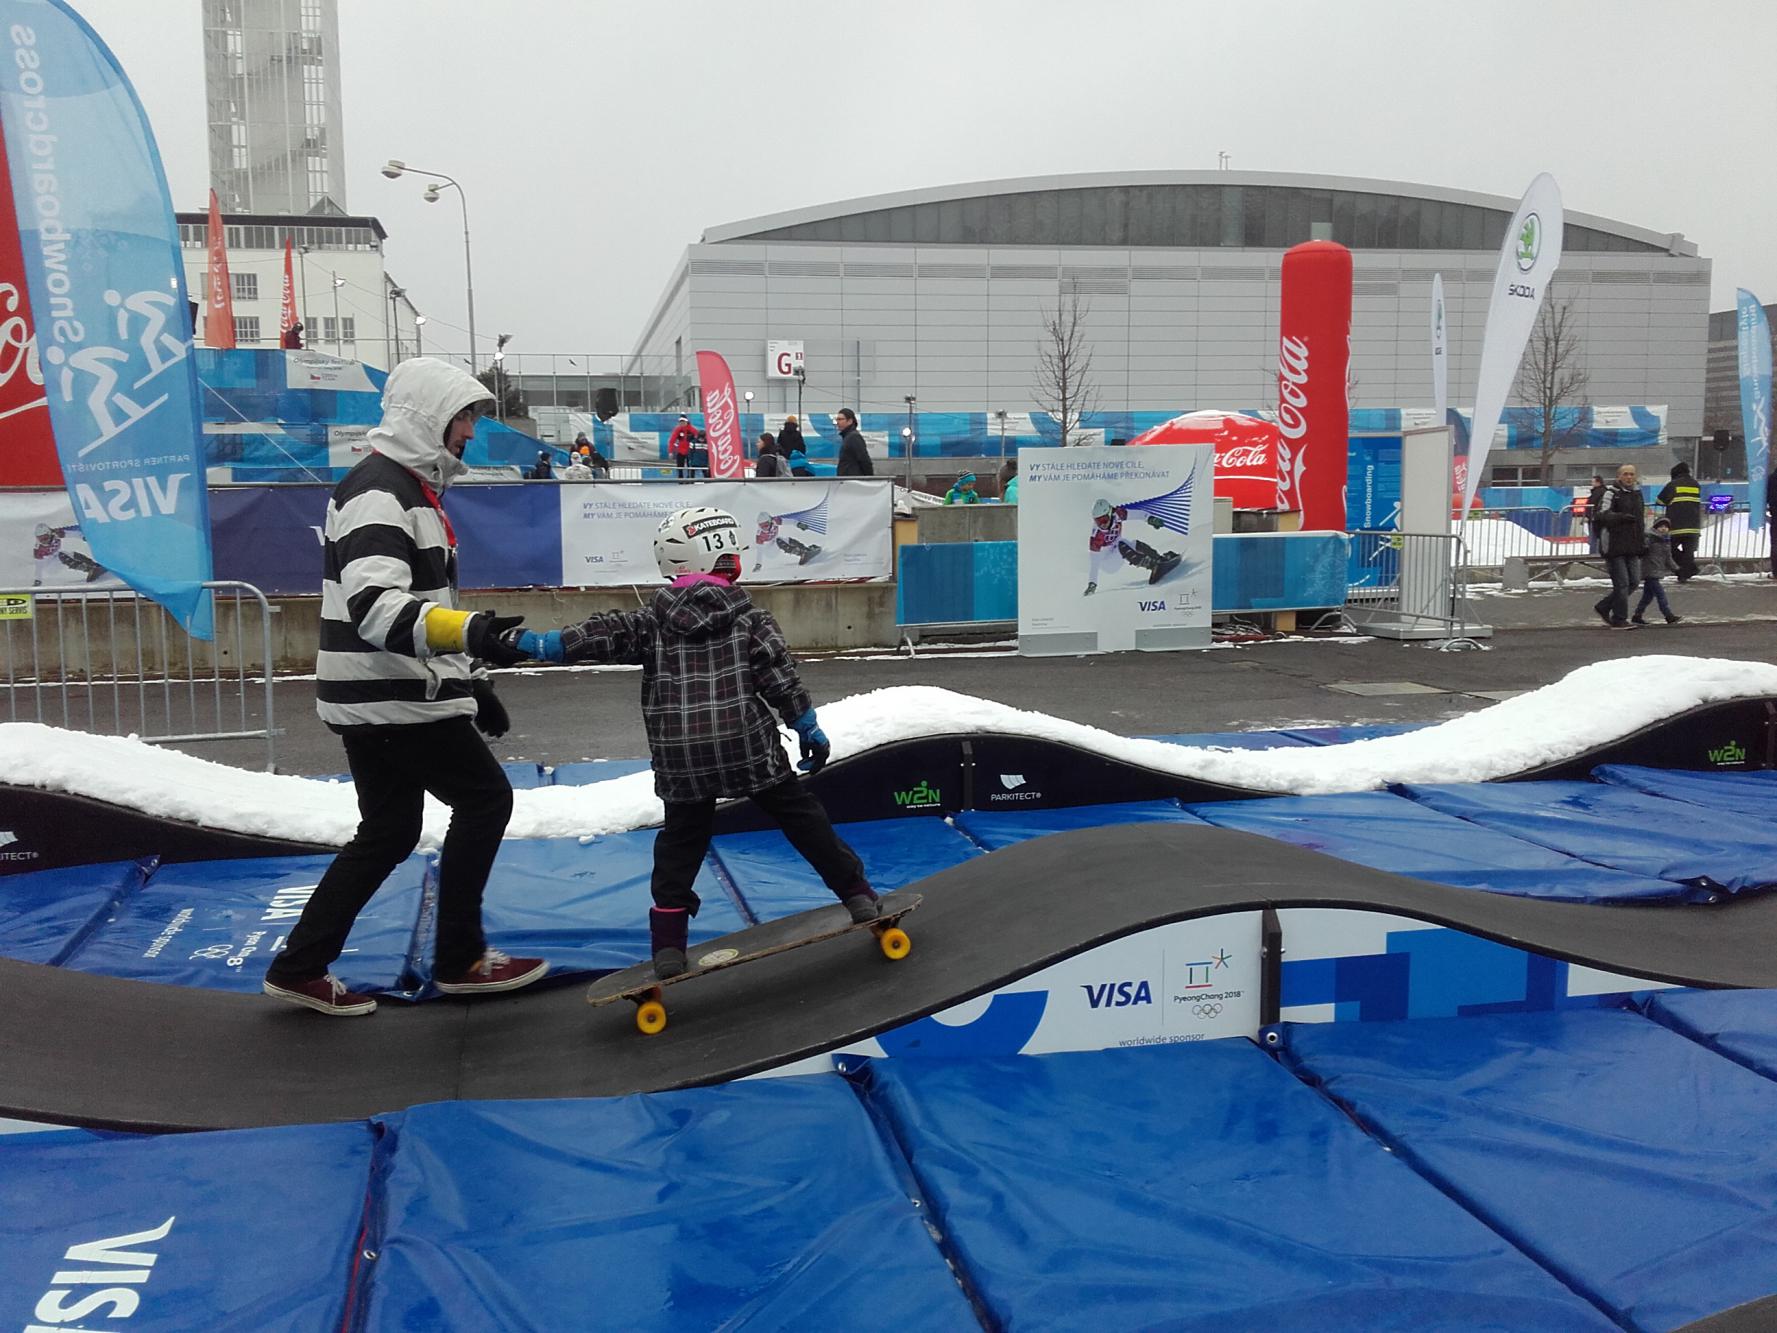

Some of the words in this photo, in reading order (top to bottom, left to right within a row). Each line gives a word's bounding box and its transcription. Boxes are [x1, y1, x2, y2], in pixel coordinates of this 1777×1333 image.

[777, 352, 792, 375] G
[1029, 463, 1041, 471] VY
[1029, 474, 1042, 482] MY
[1062, 473, 1071, 481] JE
[702, 533, 724, 552] 13
[1137, 600, 1167, 611] VISA
[894, 783, 941, 805] W2N
[1080, 980, 1153, 1009] VISA
[1173, 993, 1224, 1004] PyeongChang
[1119, 1036, 1167, 1047] worldwide
[1169, 1032, 1205, 1044] sponsor
[23, 1216, 176, 1333] VIS
